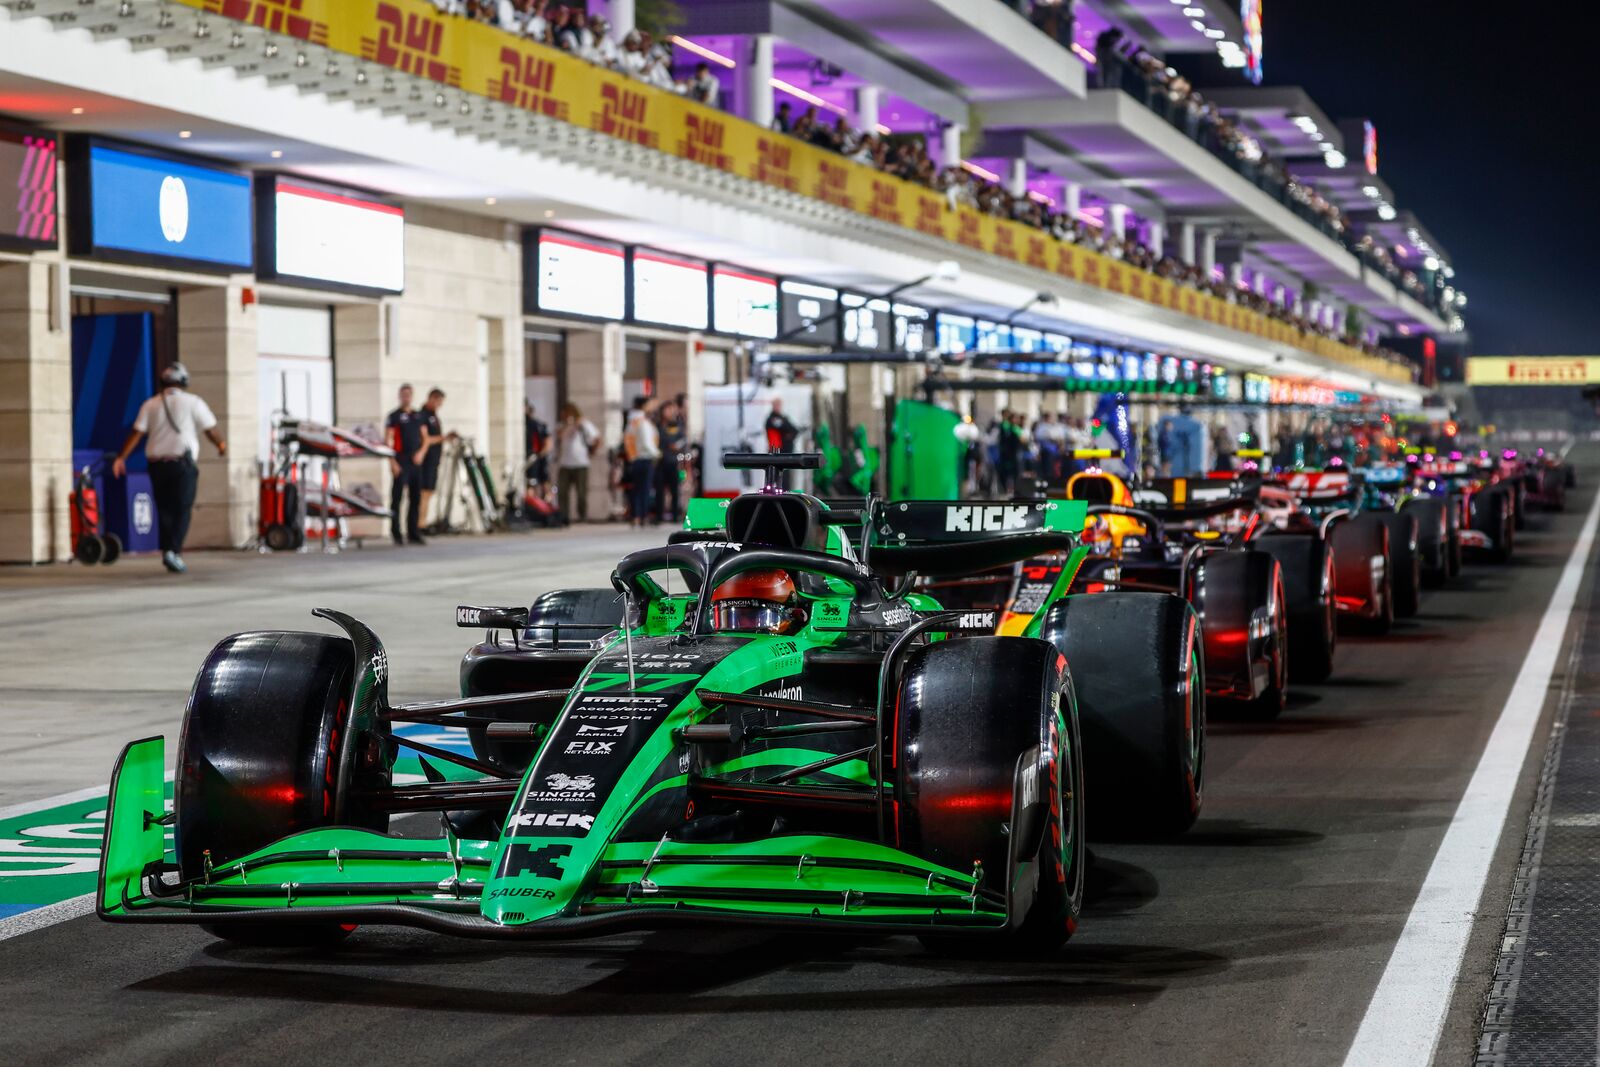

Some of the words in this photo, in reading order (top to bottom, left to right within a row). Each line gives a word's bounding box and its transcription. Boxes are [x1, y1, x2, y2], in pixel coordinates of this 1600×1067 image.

[376, 2, 447, 83] DHL
[500, 46, 557, 116] DHL
[599, 82, 649, 145] DHL
[685, 111, 729, 169] DHL
[756, 138, 793, 189] DHL
[945, 506, 1029, 532] KICK
[692, 541, 743, 552] KICK
[457, 608, 482, 624] KICK
[959, 612, 994, 629] KICK
[580, 673, 702, 692] 77
[566, 741, 617, 751] FIX
[507, 813, 595, 831] KICK
[488, 887, 556, 900] SAUBER
